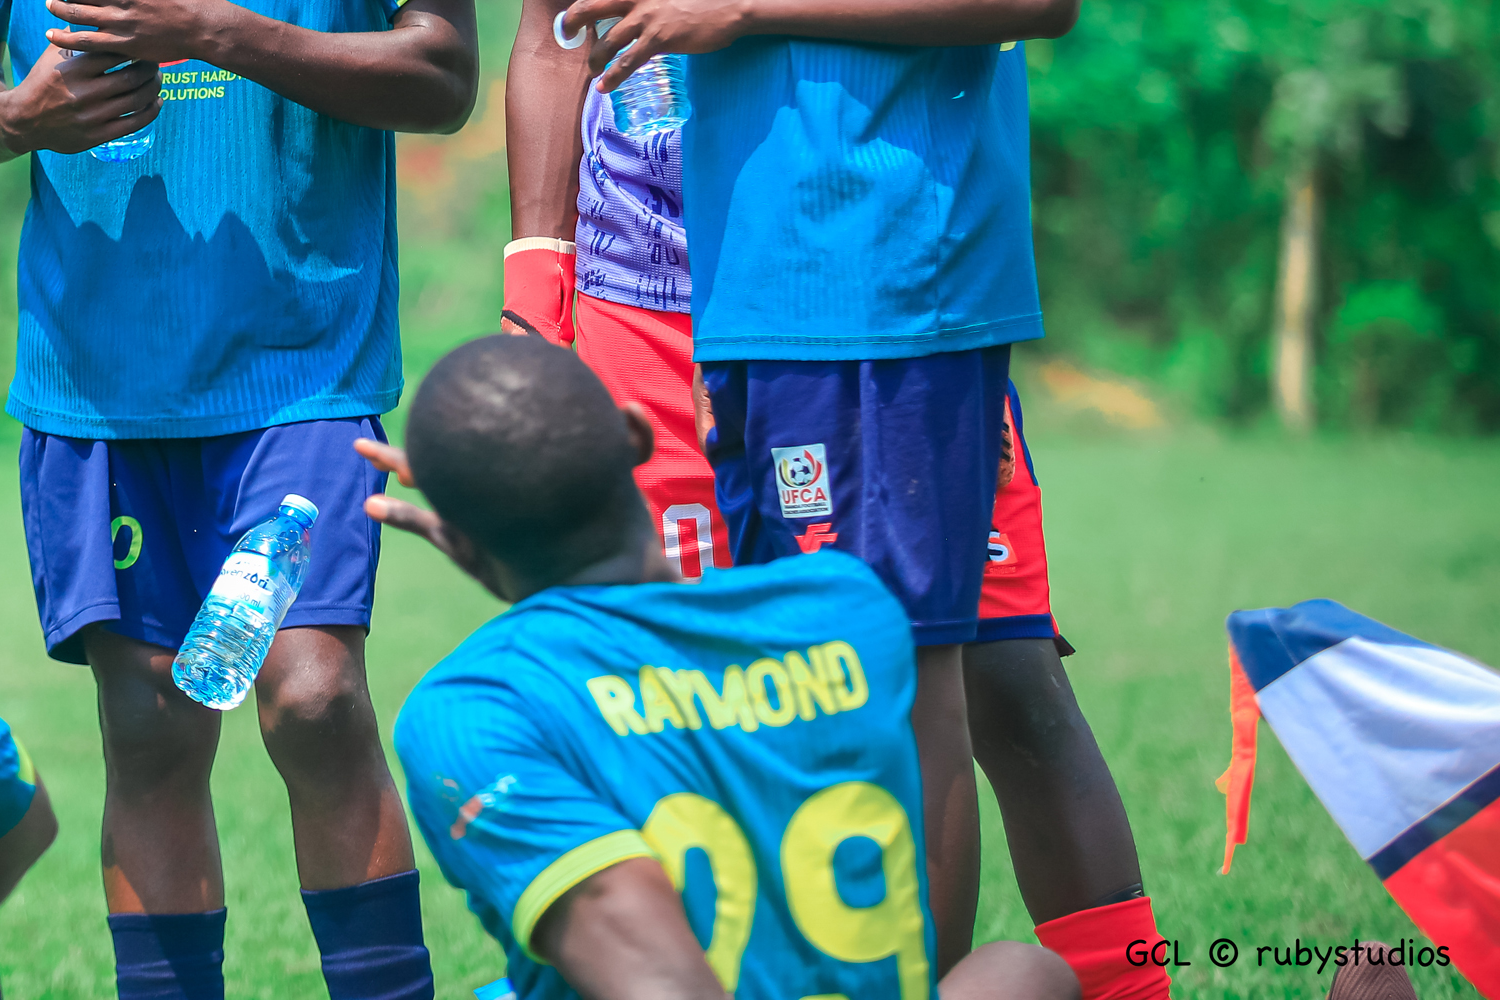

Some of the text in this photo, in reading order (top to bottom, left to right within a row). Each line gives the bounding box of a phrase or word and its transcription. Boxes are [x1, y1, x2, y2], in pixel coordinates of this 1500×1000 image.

[161, 70, 242, 84] RUST HARD
[158, 86, 225, 101] OLUTIONS
[782, 487, 827, 504] UFCA
[586, 640, 869, 737] RAYMOND
